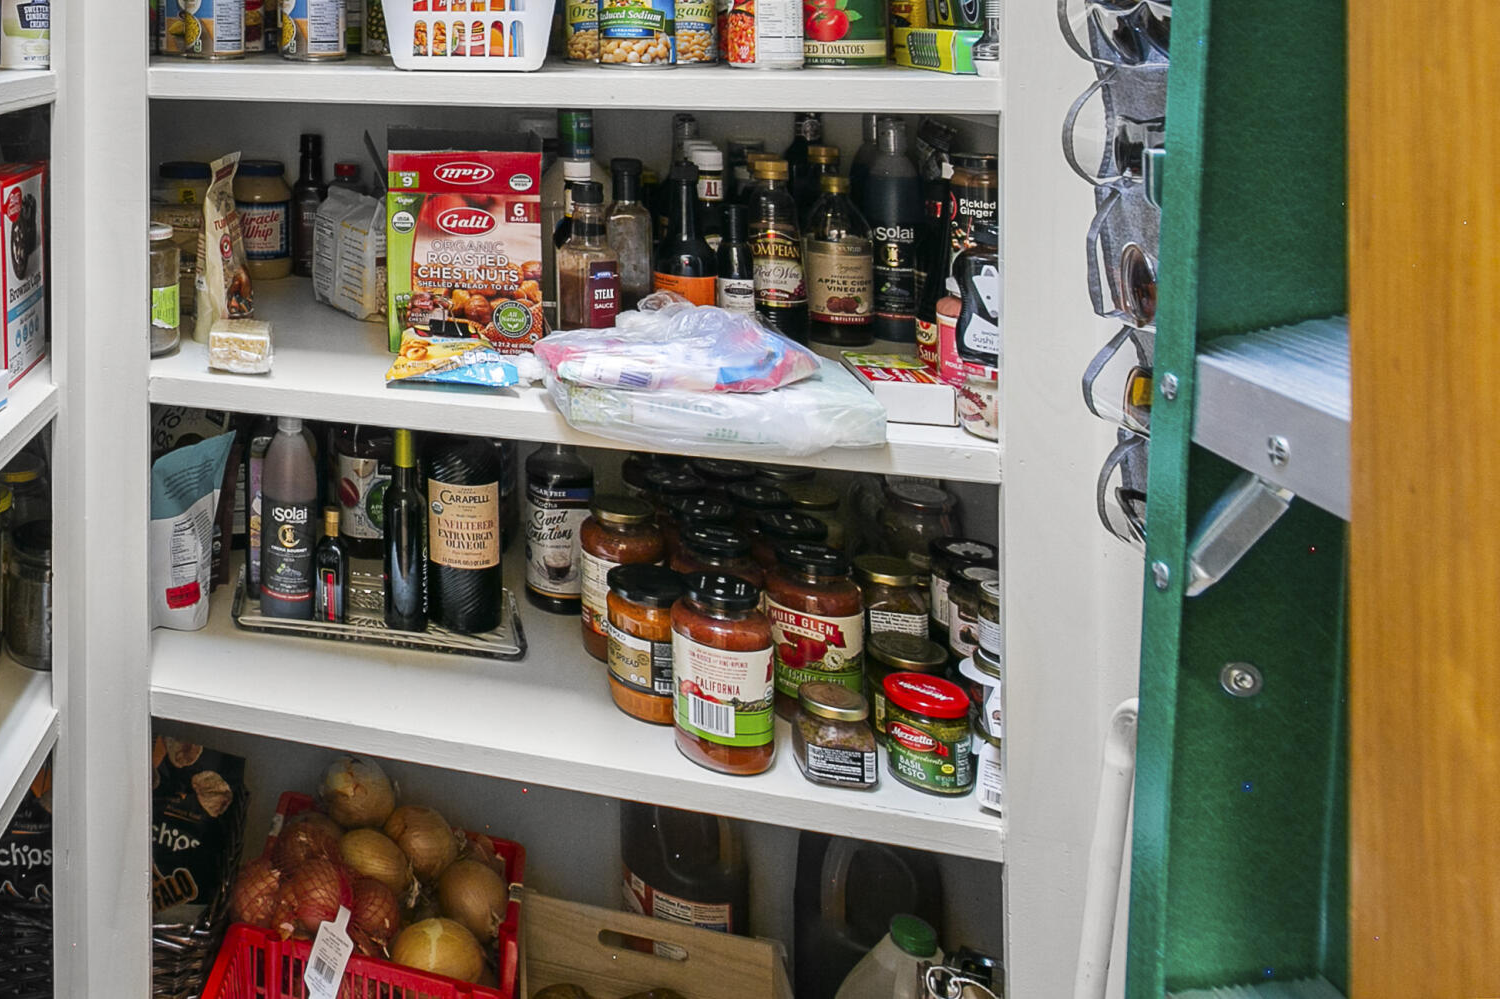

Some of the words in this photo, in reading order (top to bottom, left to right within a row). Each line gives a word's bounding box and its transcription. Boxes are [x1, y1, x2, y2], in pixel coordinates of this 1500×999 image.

[820, 43, 866, 55] TOMATOES
[513, 203, 525, 216] 6
[959, 198, 996, 210] Pickled
[959, 207, 994, 219] Ginger
[442, 212, 490, 230] Galil
[431, 239, 504, 254] ORGANIC
[426, 252, 509, 268] ROASTED
[417, 266, 519, 283] CHESTNUTS
[417, 281, 453, 289] SHELLED
[461, 282, 489, 290] READY
[503, 284, 519, 292] EAT
[817, 277, 847, 287] APPLE
[594, 288, 614, 300] STEAK
[972, 333, 994, 345] Sushi
[801, 617, 834, 637] GLEN
[695, 676, 741, 697] CALIFORNIA
[899, 755, 925, 772] BASIL
[898, 763, 927, 781] PESTO
